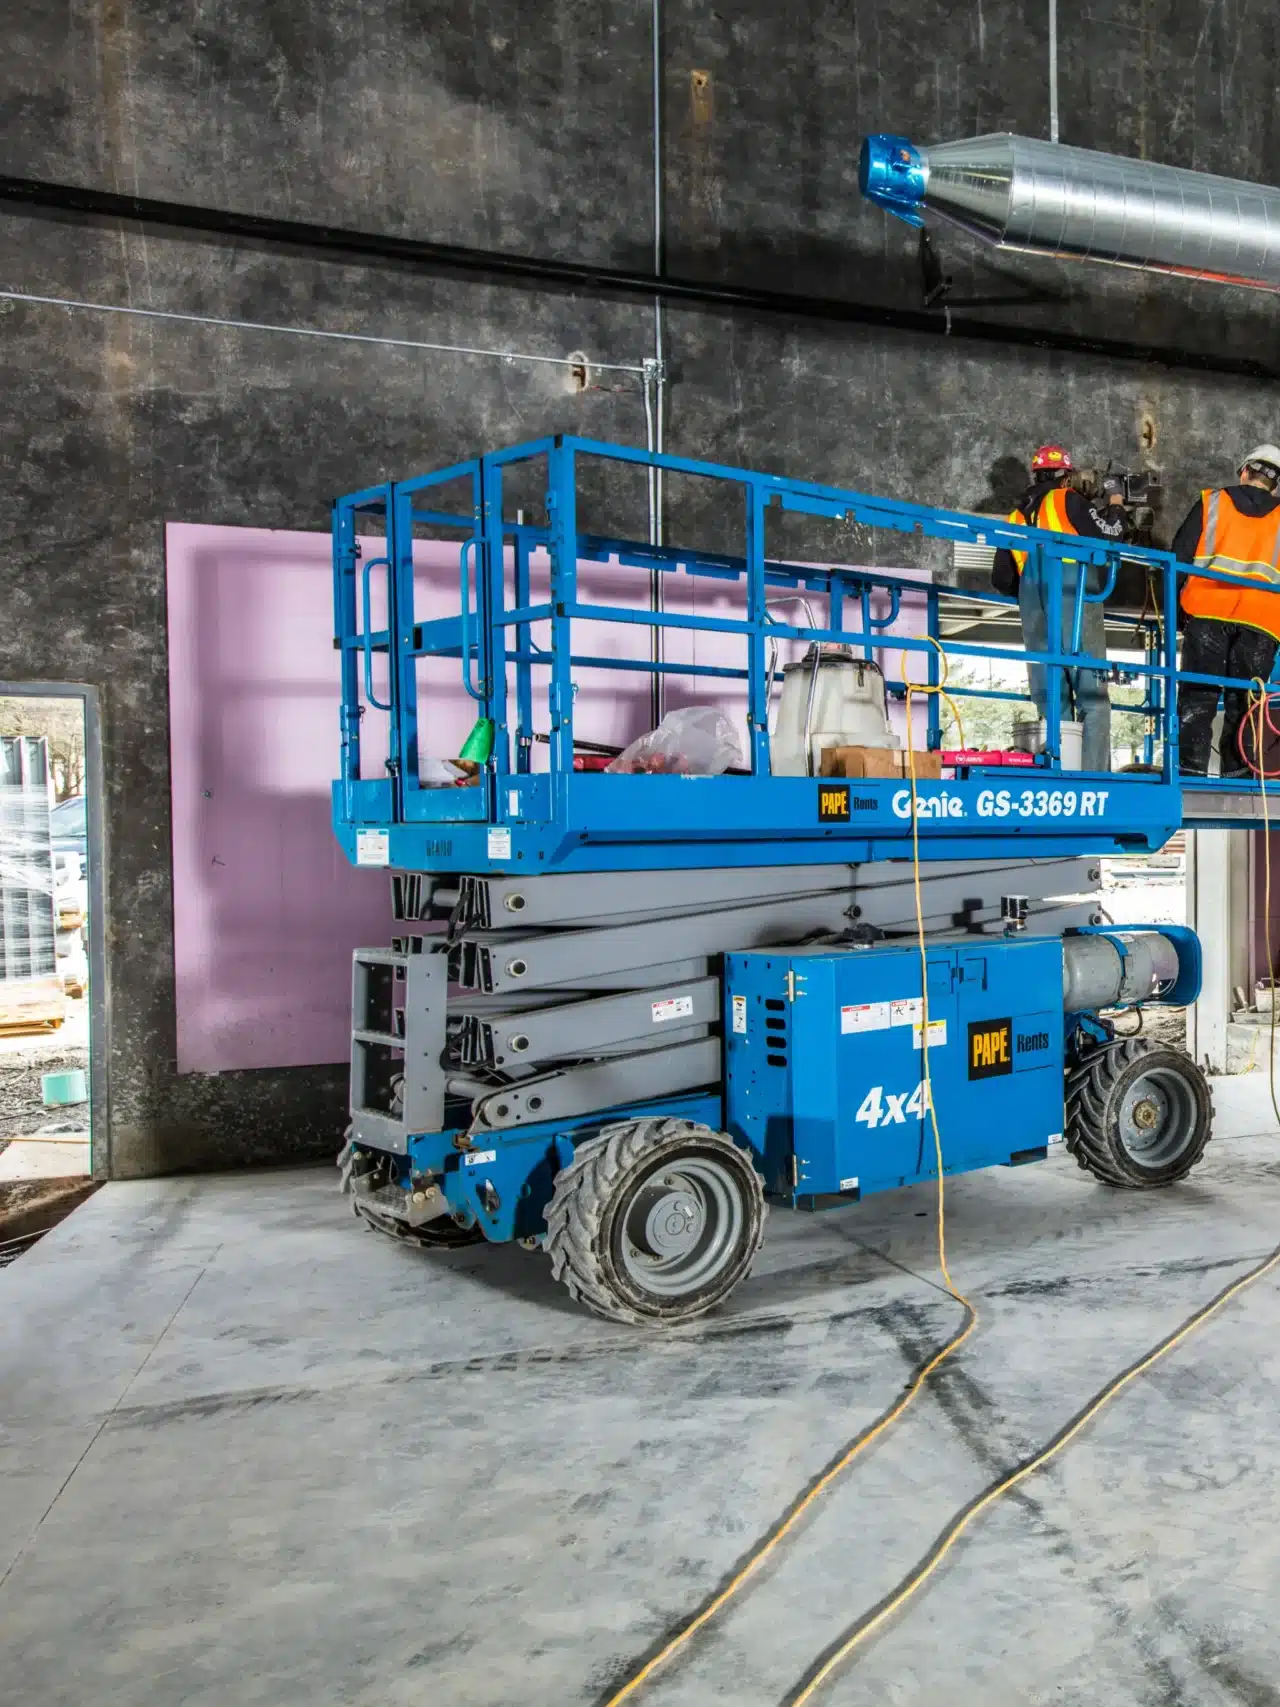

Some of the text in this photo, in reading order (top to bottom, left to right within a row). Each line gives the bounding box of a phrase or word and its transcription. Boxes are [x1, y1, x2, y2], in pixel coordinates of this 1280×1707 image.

[853, 795, 878, 811] Rents
[892, 789, 964, 819] Genie
[976, 791, 1109, 817] GS-3369 RT
[1016, 1031, 1049, 1053] Rents
[855, 1078, 931, 1129] 4x4
